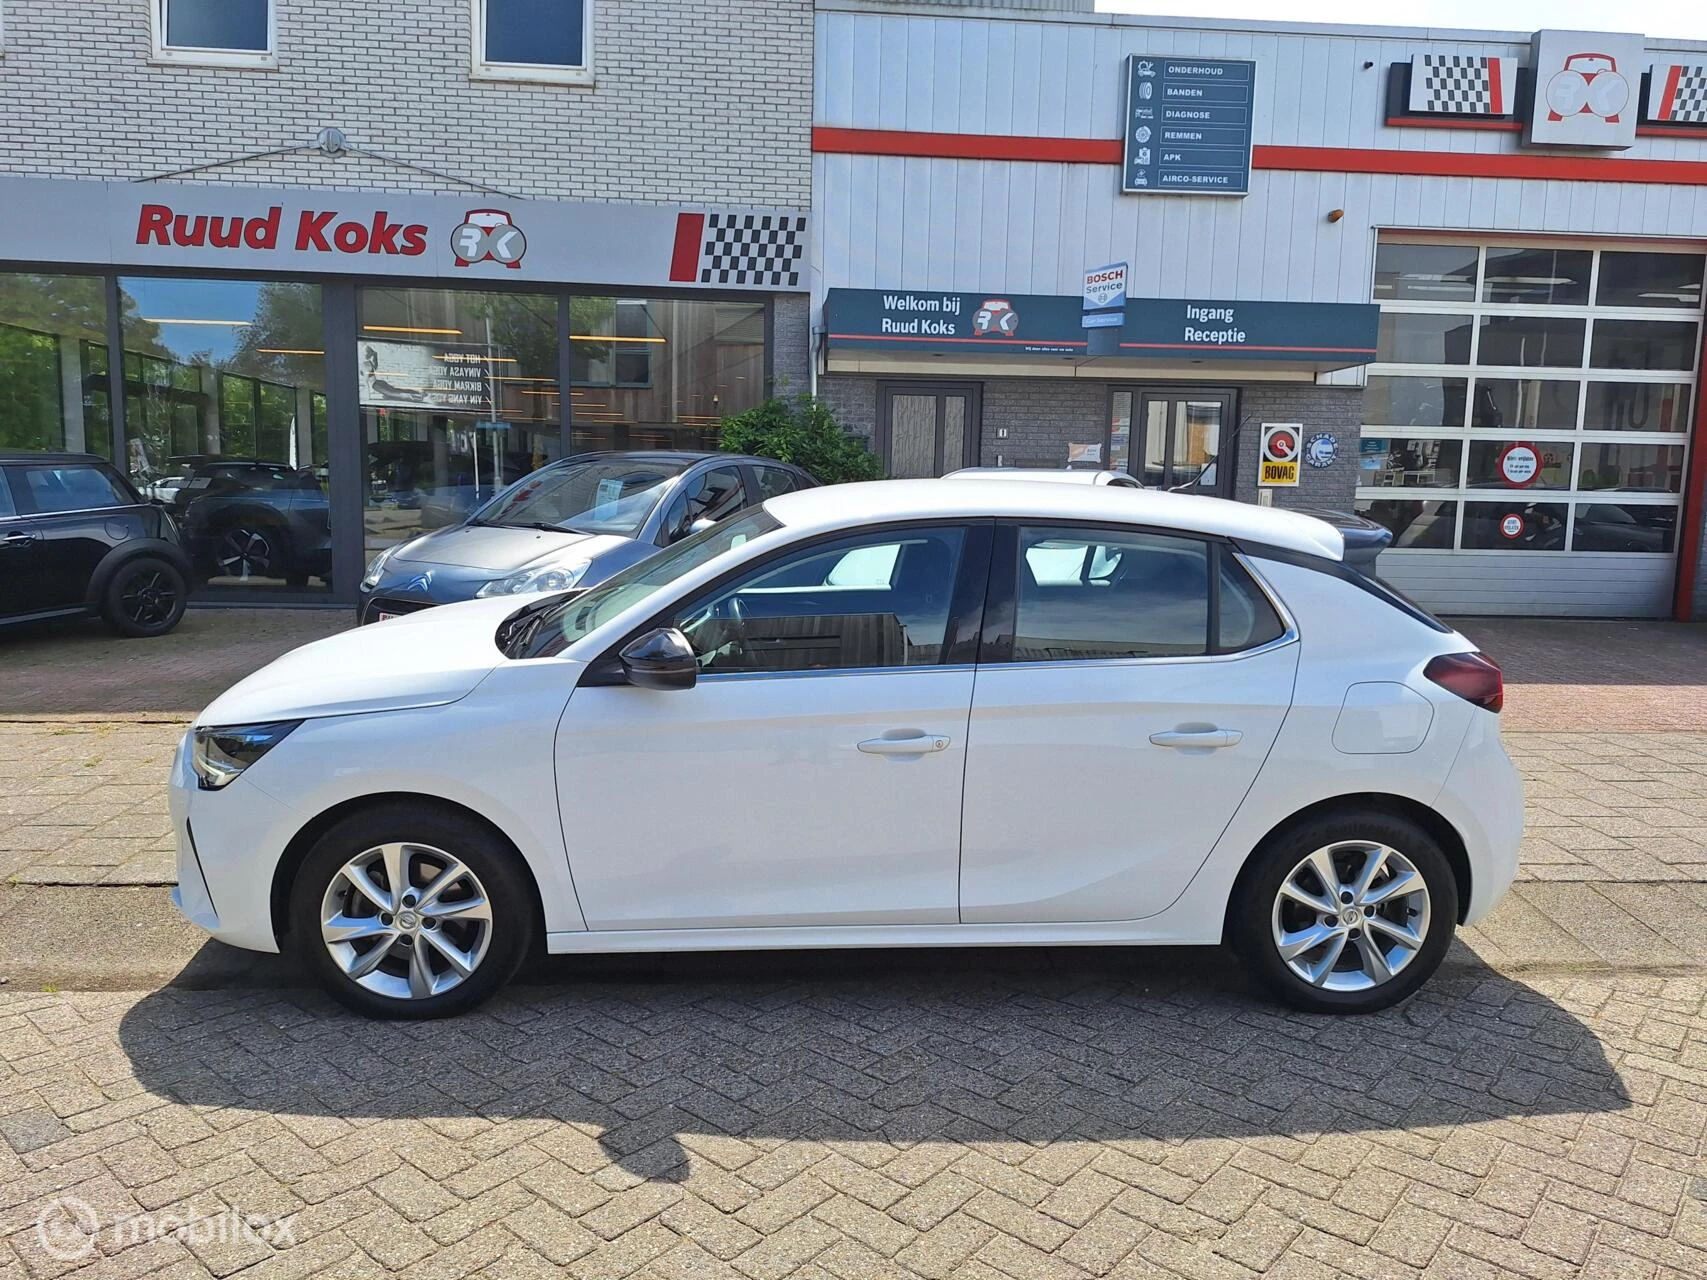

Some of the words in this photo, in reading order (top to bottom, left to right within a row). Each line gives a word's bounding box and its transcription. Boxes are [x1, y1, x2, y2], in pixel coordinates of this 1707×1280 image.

[1168, 65, 1224, 76] ONDERHOUD
[1166, 87, 1203, 97] BANDEN
[1165, 110, 1211, 119] DIAGNOSE
[1164, 131, 1202, 140] REMMEN
[1163, 153, 1182, 161] APK
[1162, 174, 1229, 184] AIRCO-SERVICE
[136, 203, 282, 249] Ruud
[294, 210, 428, 256] Koks
[1086, 269, 1124, 285] BOSCH
[1086, 281, 1123, 294] Service
[883, 295, 939, 312] Welkom
[942, 297, 961, 316] bij
[1186, 304, 1234, 323] Ingang
[881, 318, 918, 333] Ruud
[921, 319, 955, 335] Koks
[1184, 327, 1246, 345] Receptie
[1306, 433, 1338, 449] SCHADE
[1264, 465, 1295, 480] BOVAG
